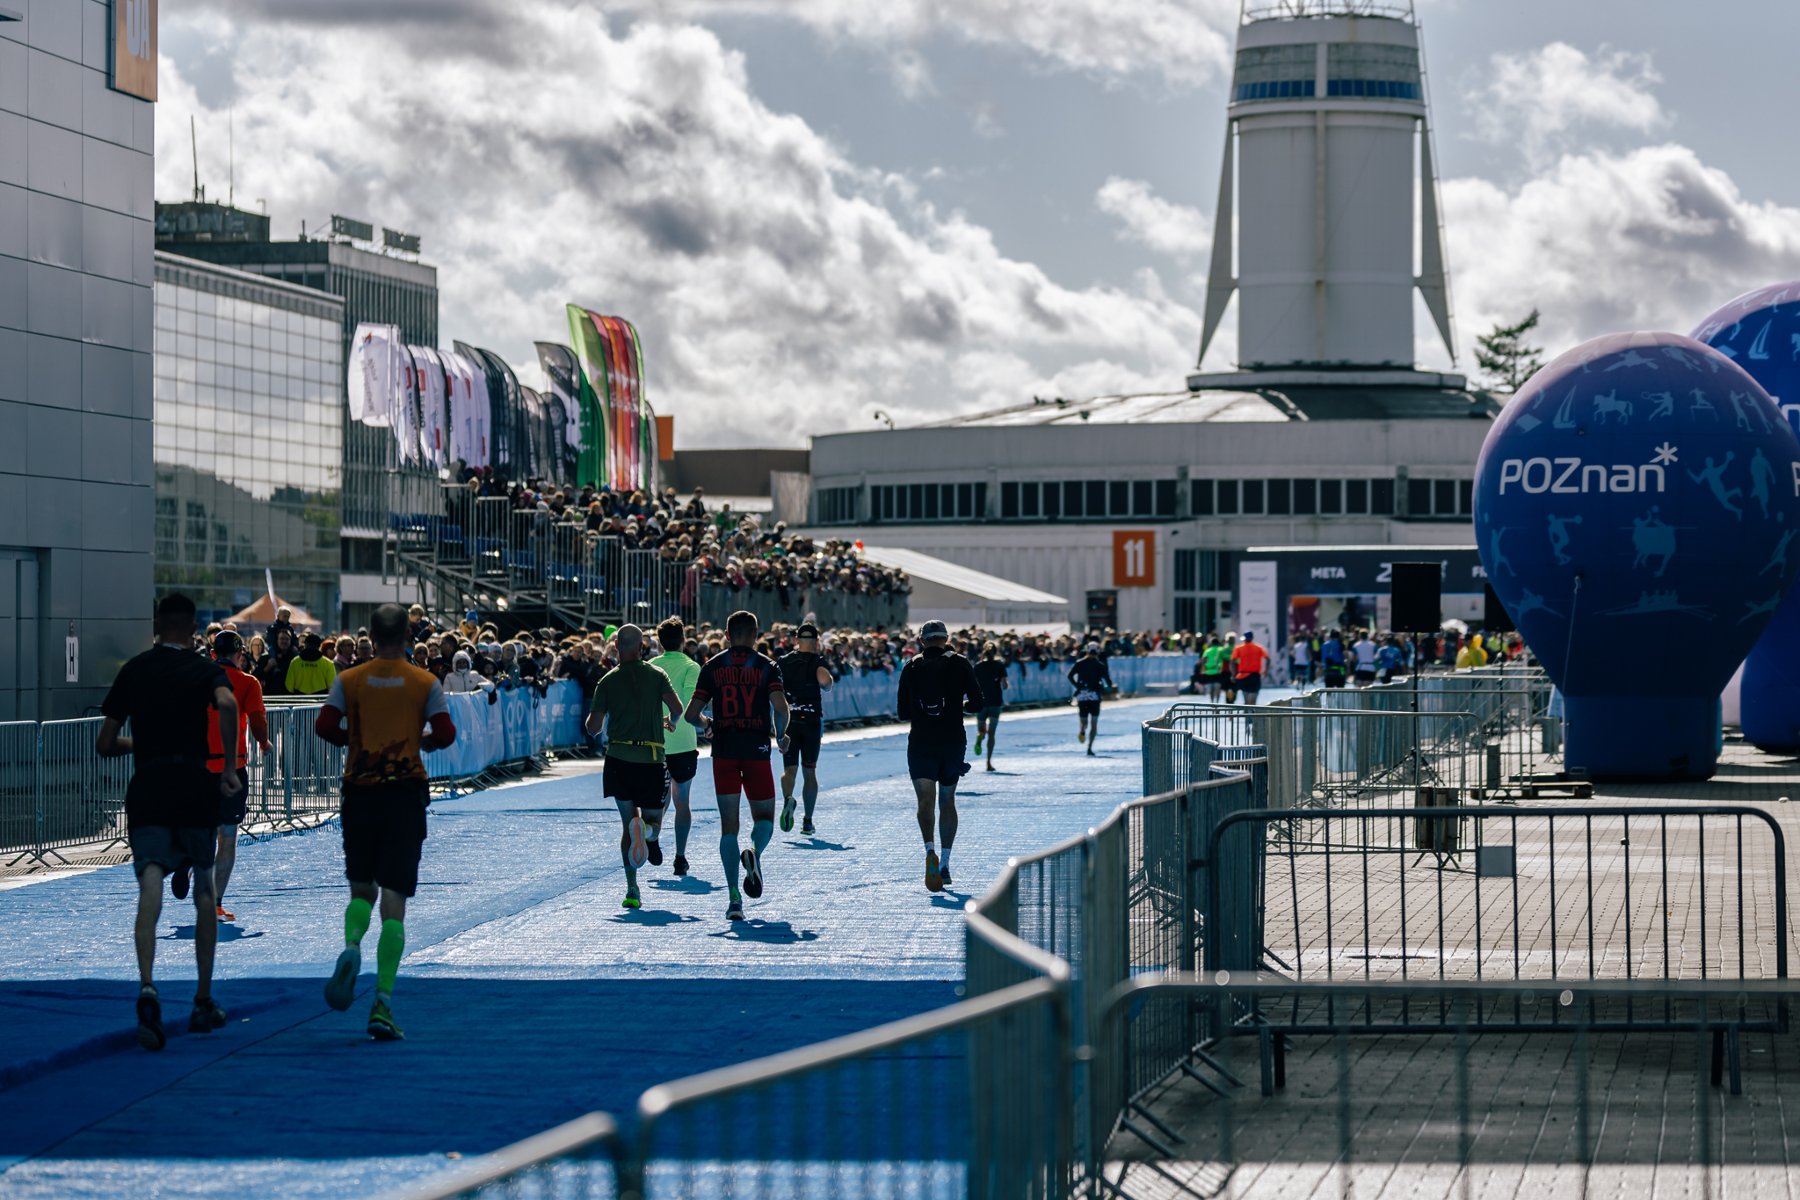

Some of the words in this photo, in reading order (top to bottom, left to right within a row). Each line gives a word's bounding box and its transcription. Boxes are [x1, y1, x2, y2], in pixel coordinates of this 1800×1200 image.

[1123, 538, 1145, 577] 11
[1311, 567, 1347, 579] META
[713, 666, 764, 688] URODZONY
[721, 685, 757, 718] BY
